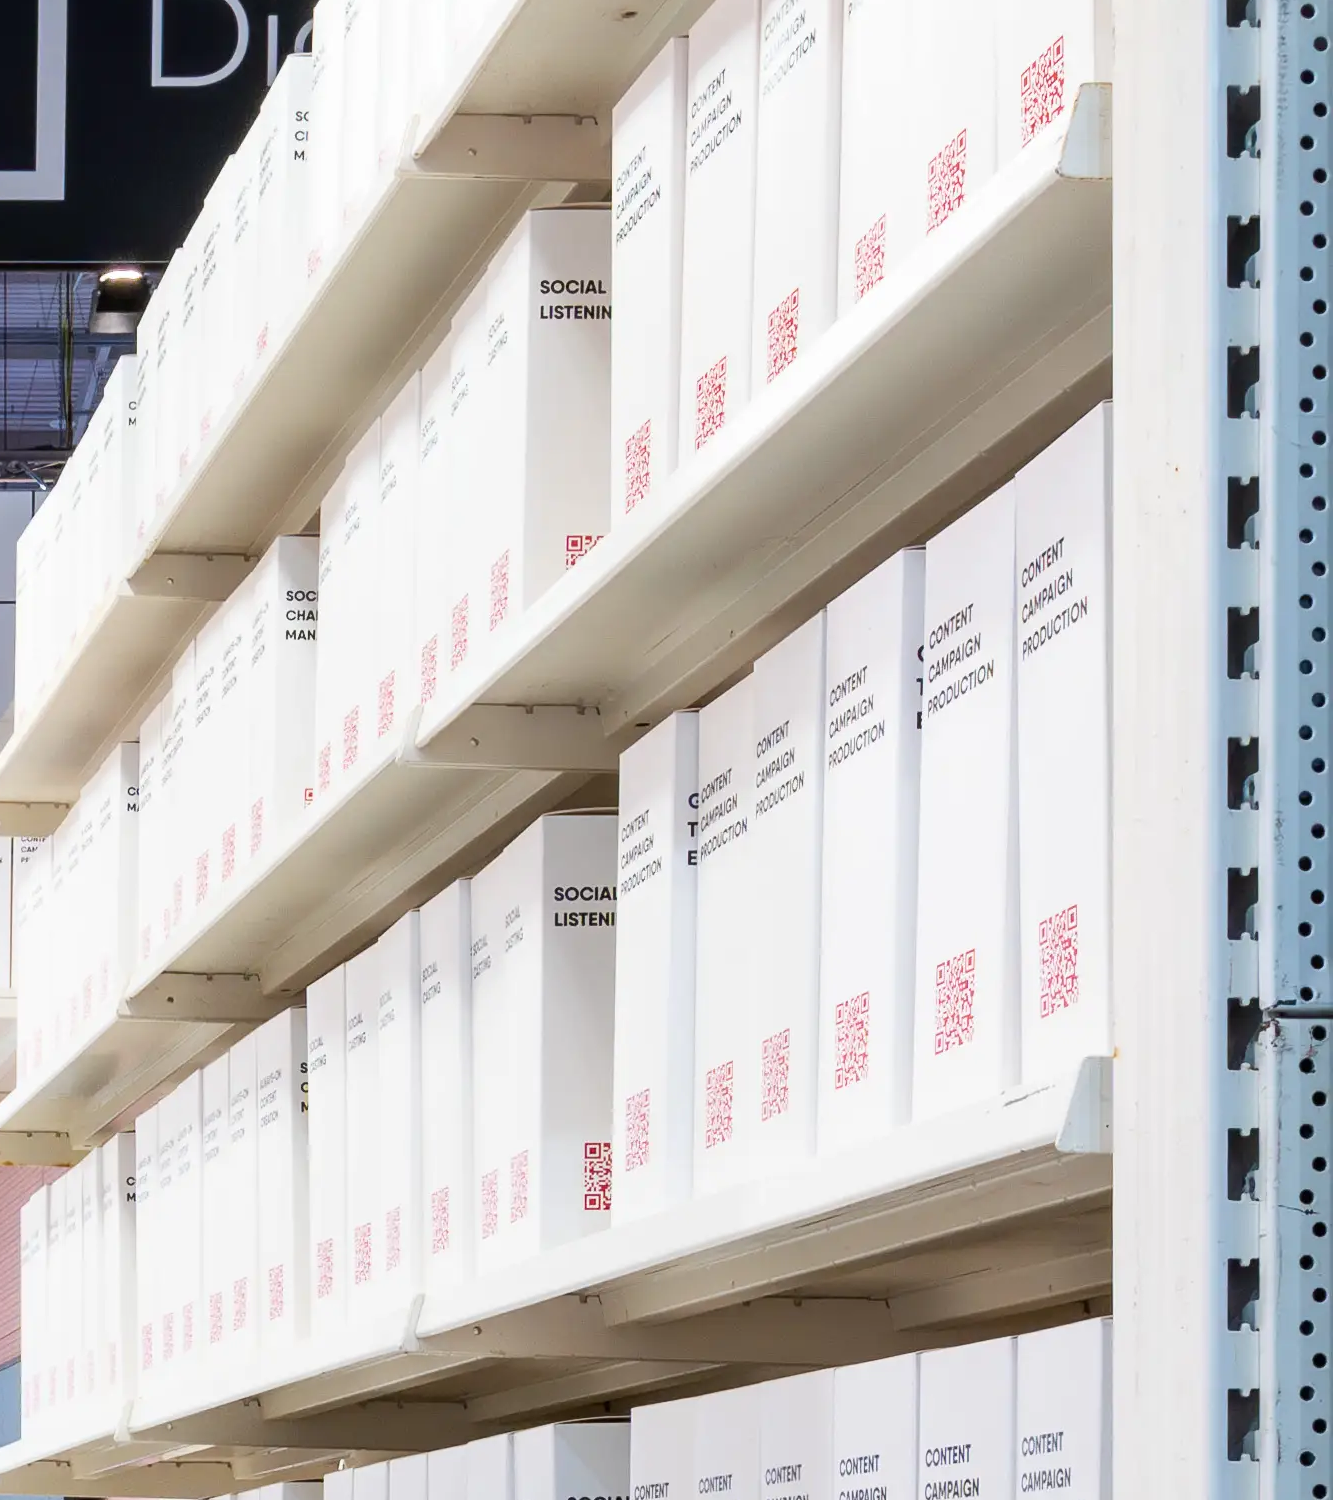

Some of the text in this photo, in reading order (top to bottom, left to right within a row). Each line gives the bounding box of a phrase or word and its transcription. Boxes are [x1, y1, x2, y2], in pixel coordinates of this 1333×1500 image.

[691, 67, 726, 119] CONTENT
[690, 91, 731, 147] CAMPAIGN
[690, 110, 742, 172] PRODUCTION
[540, 279, 606, 294] SOCIAL
[1021, 536, 1064, 588] CONTENT
[1021, 567, 1072, 623] CAMPAIGN
[929, 603, 973, 649] CONTENT
[1022, 596, 1087, 659] PRODUCTION
[928, 632, 981, 683] CAMPAIGN
[829, 665, 867, 707] CONTENT
[927, 659, 994, 716] PRODUCTION
[828, 694, 873, 739] CAMPAIGN
[828, 719, 884, 767] PRODUCTION
[839, 1454, 879, 1477] CONTENT
[925, 1443, 971, 1467] CONTENT
[1021, 1431, 1063, 1457] CONTENT
[924, 1477, 979, 1500] CAMPAIGN
[1021, 1467, 1071, 1492] CAMPAIGN
